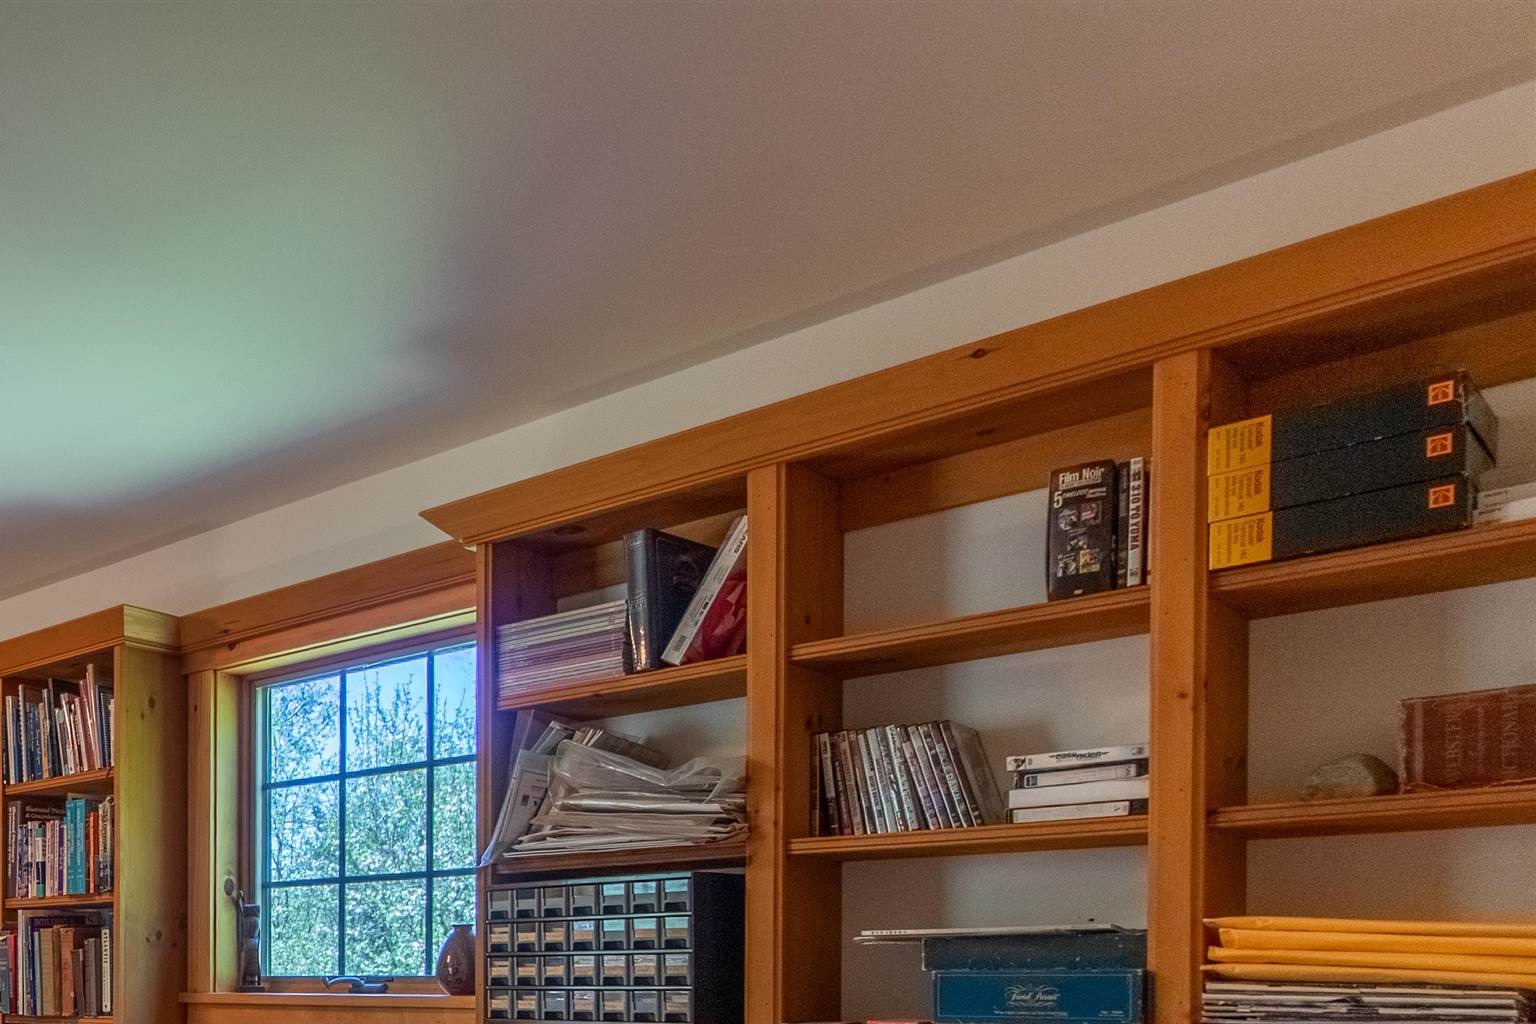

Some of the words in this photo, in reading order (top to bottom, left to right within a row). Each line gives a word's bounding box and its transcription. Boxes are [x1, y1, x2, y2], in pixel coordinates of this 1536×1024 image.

[1059, 471, 1080, 485] Film
[1082, 466, 1105, 480] Noir
[1053, 490, 1064, 509] 5
[1131, 505, 1140, 519] TO
[1130, 520, 1140, 551] YUMA
